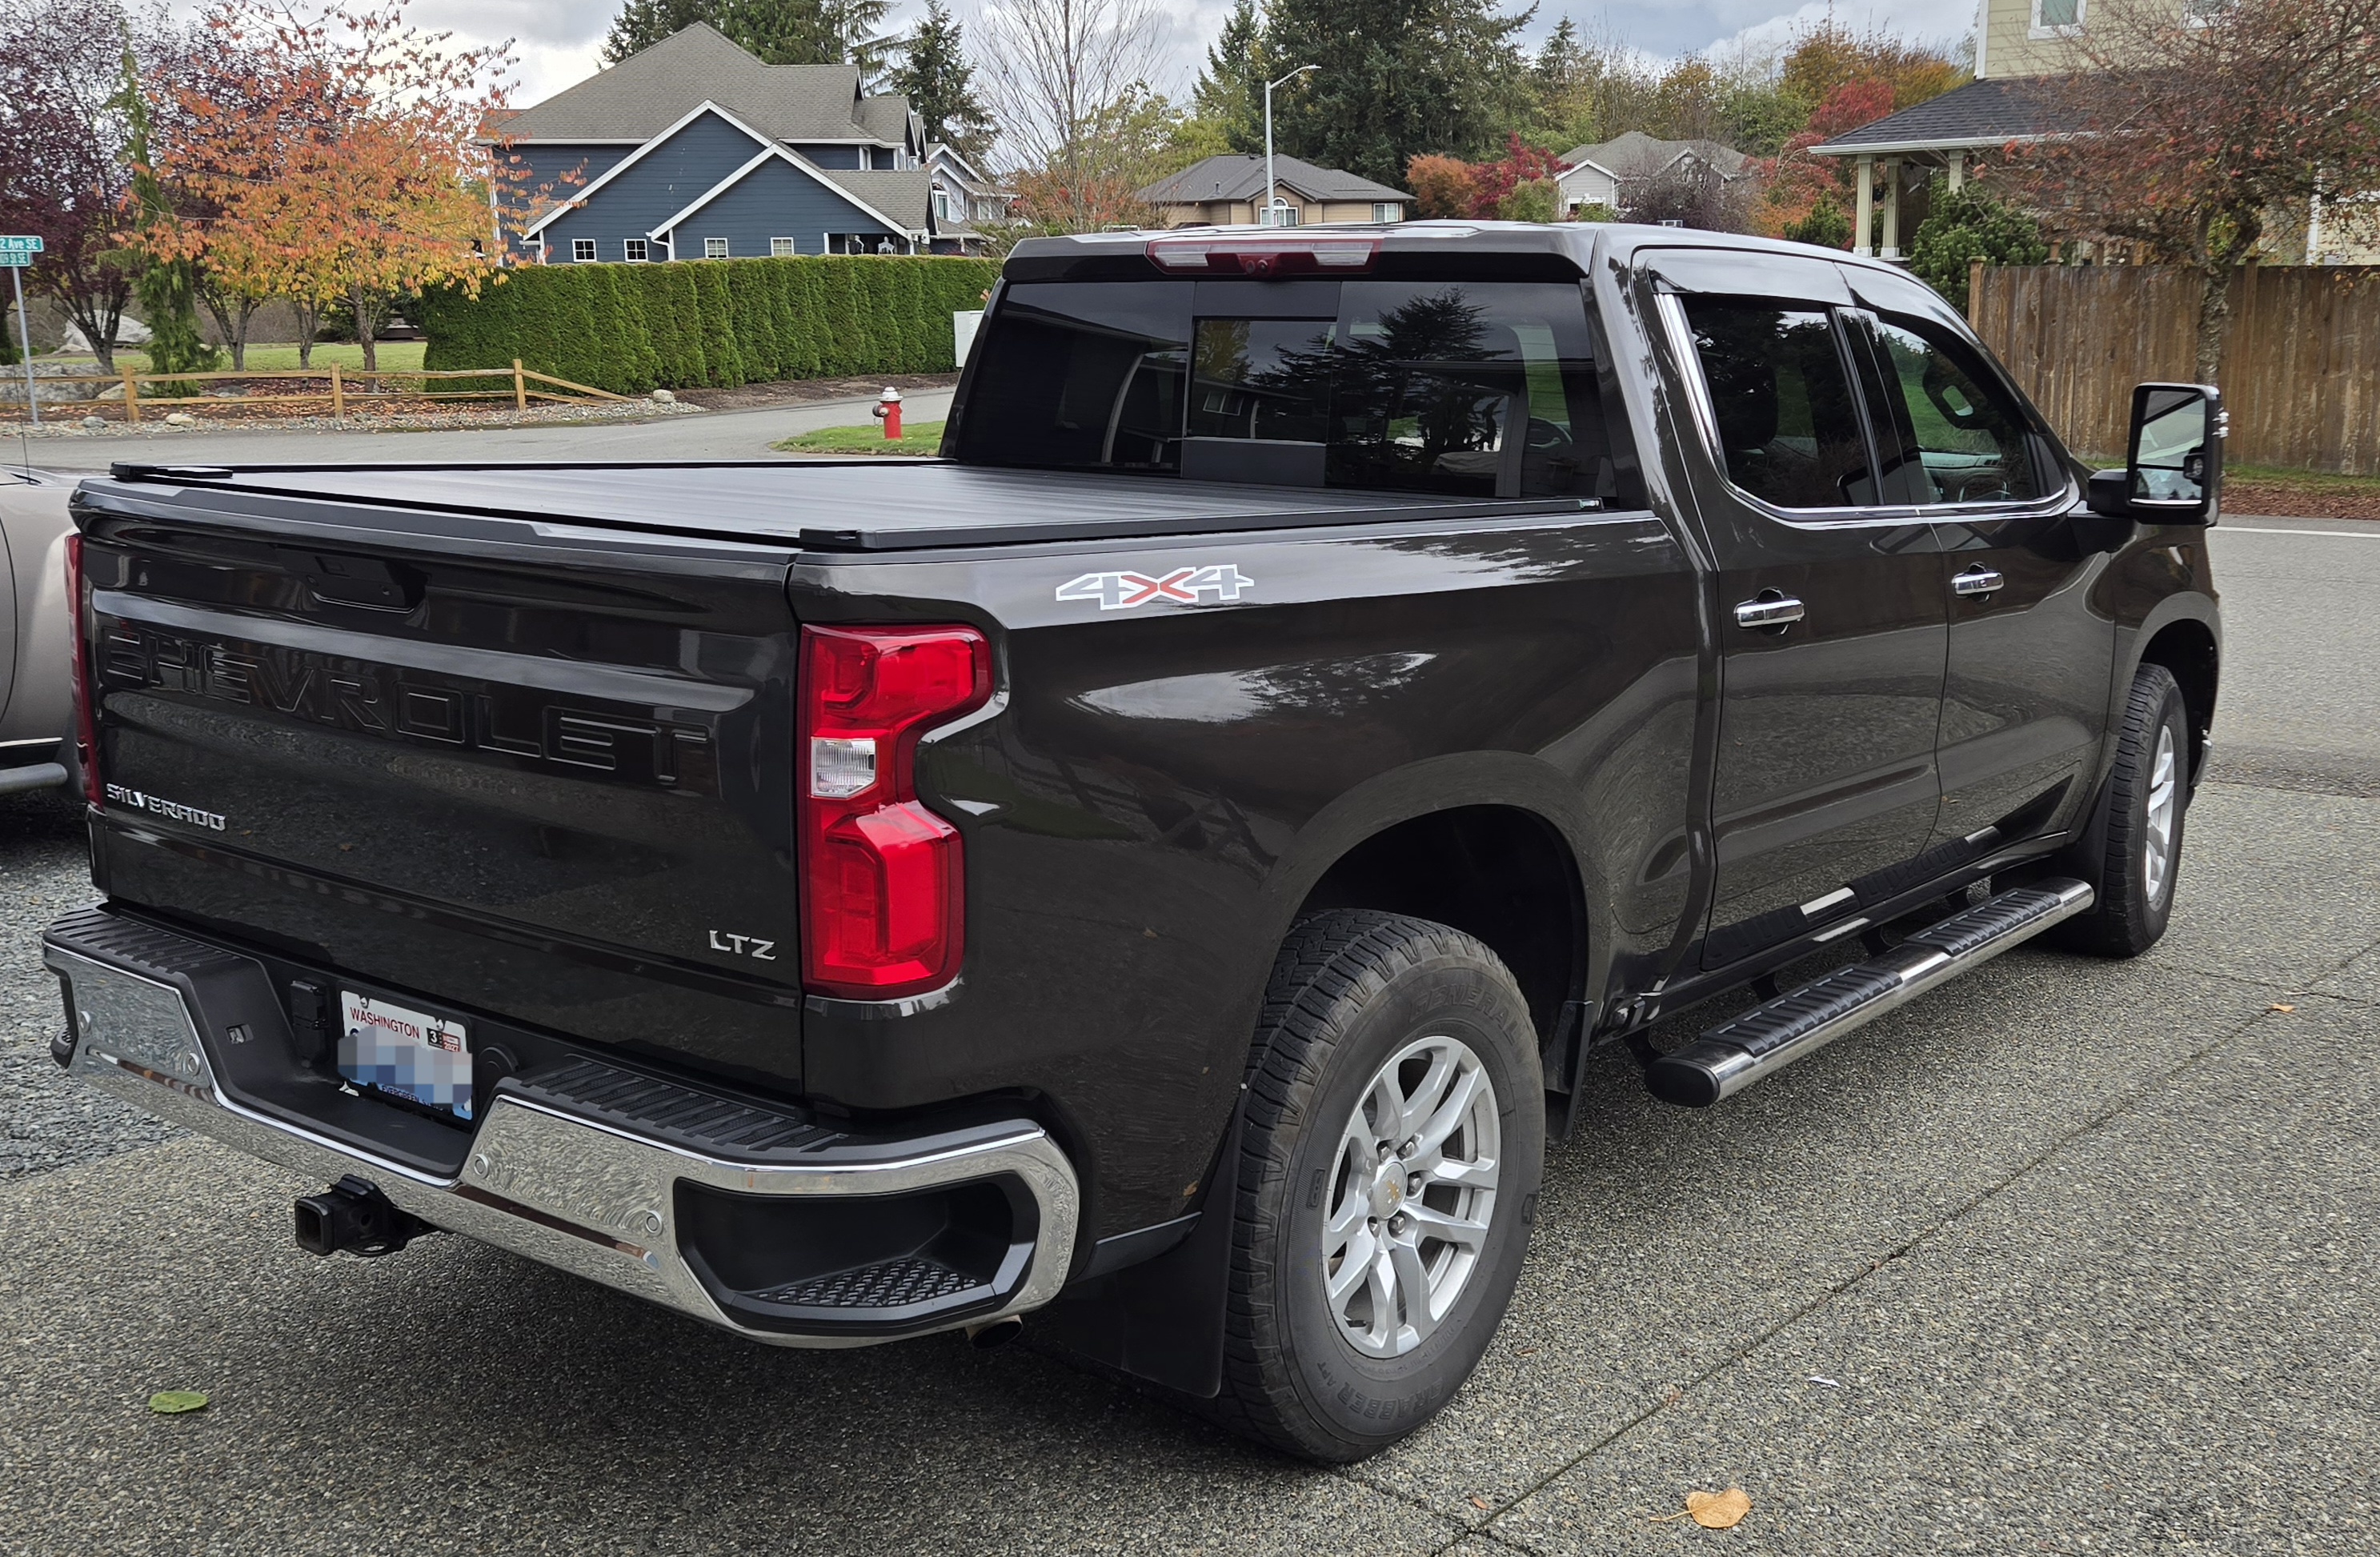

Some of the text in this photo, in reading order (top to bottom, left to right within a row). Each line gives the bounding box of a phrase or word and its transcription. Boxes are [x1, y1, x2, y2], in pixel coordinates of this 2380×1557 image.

[8, 238, 25, 250] Ave
[26, 238, 38, 250] SE
[17, 252, 27, 264] SE
[101, 626, 711, 788] CHEVROLET
[106, 783, 226, 831] SILVERADO
[709, 930, 776, 961] LTZ
[350, 1007, 420, 1039] WASHINGTON
[1408, 983, 1518, 1047] GENERAL
[430, 1031, 438, 1043] 3
[1337, 1378, 1444, 1420] GRABBER
